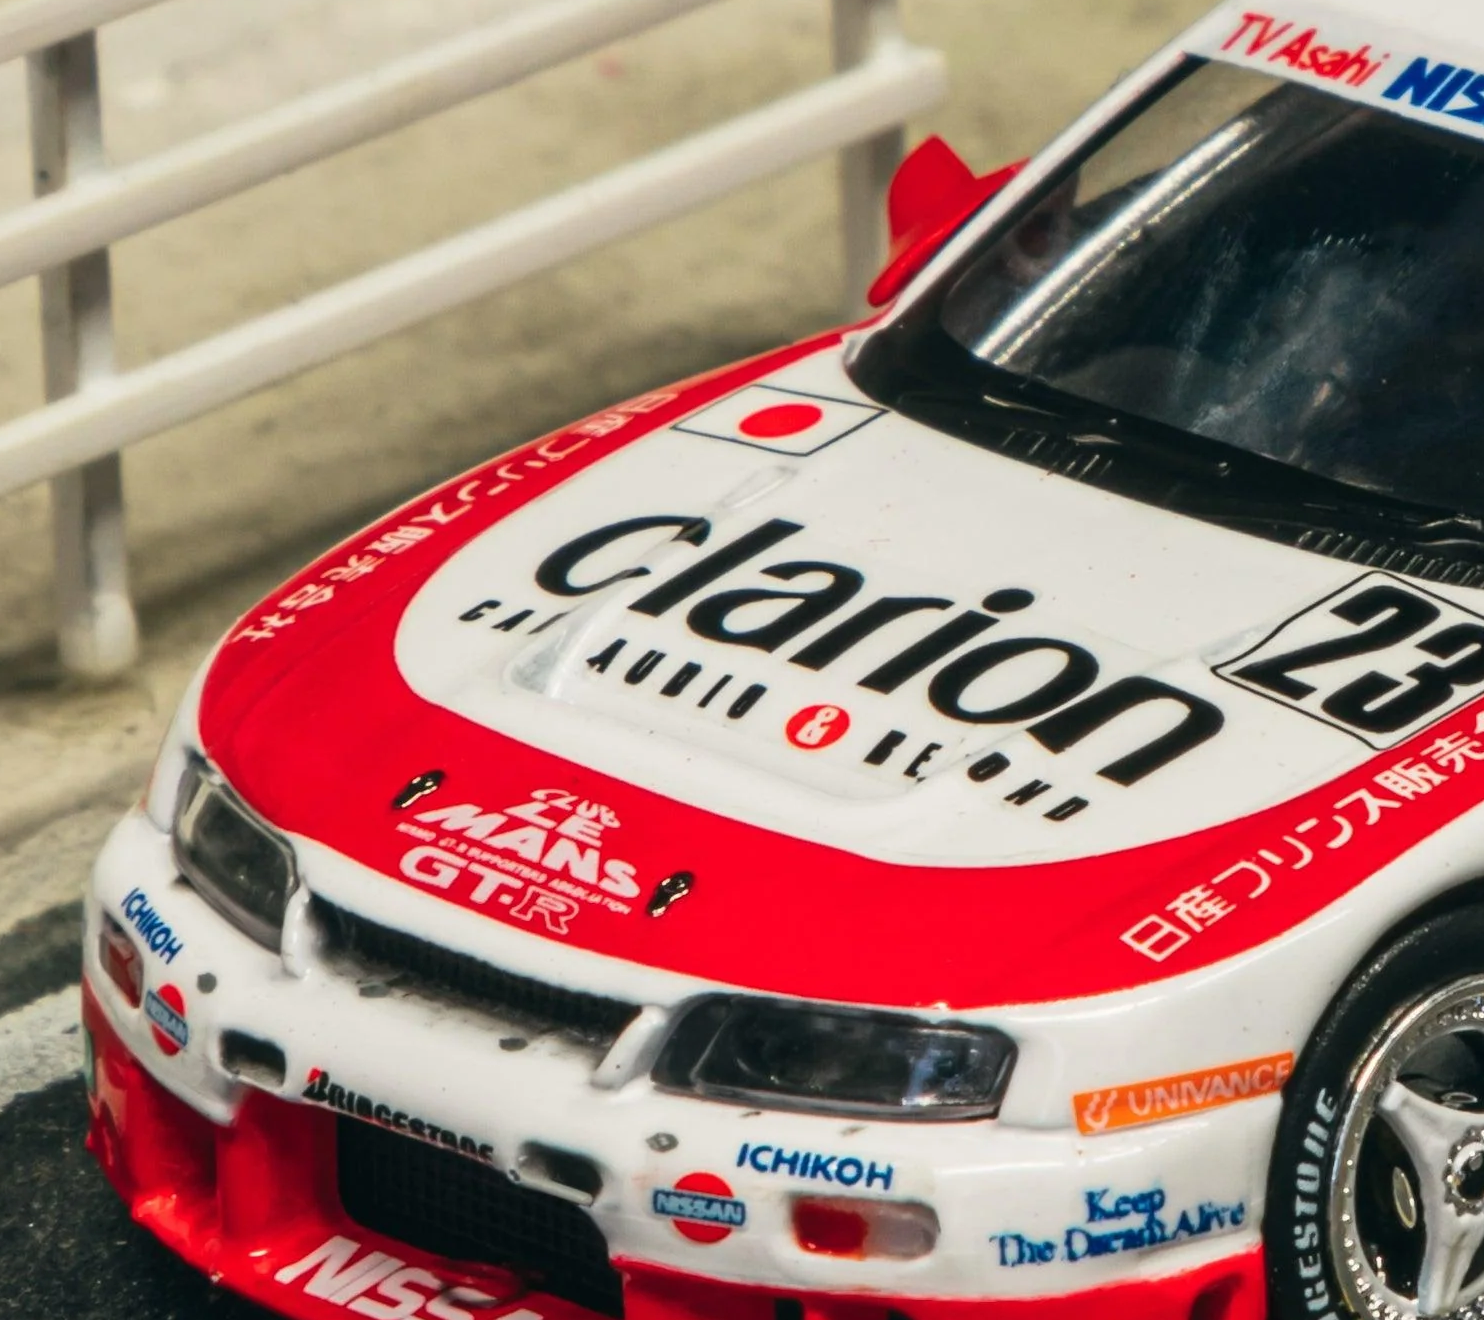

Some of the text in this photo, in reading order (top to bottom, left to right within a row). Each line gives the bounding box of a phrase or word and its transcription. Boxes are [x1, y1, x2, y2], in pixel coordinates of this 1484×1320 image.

[1221, 12, 1390, 87] TV Asahi
[584, 636, 768, 719] AUDIO
[863, 728, 1090, 822] BEOND
[413, 803, 641, 899] MANS
[503, 800, 605, 848] LE
[121, 887, 184, 966] ICHIKOH
[1128, 1058, 1291, 1116] UNIVANCE
[737, 1143, 894, 1190] ICHIKOH
[654, 1191, 744, 1224] NISSAN
[1084, 1187, 1166, 1229] Keep
